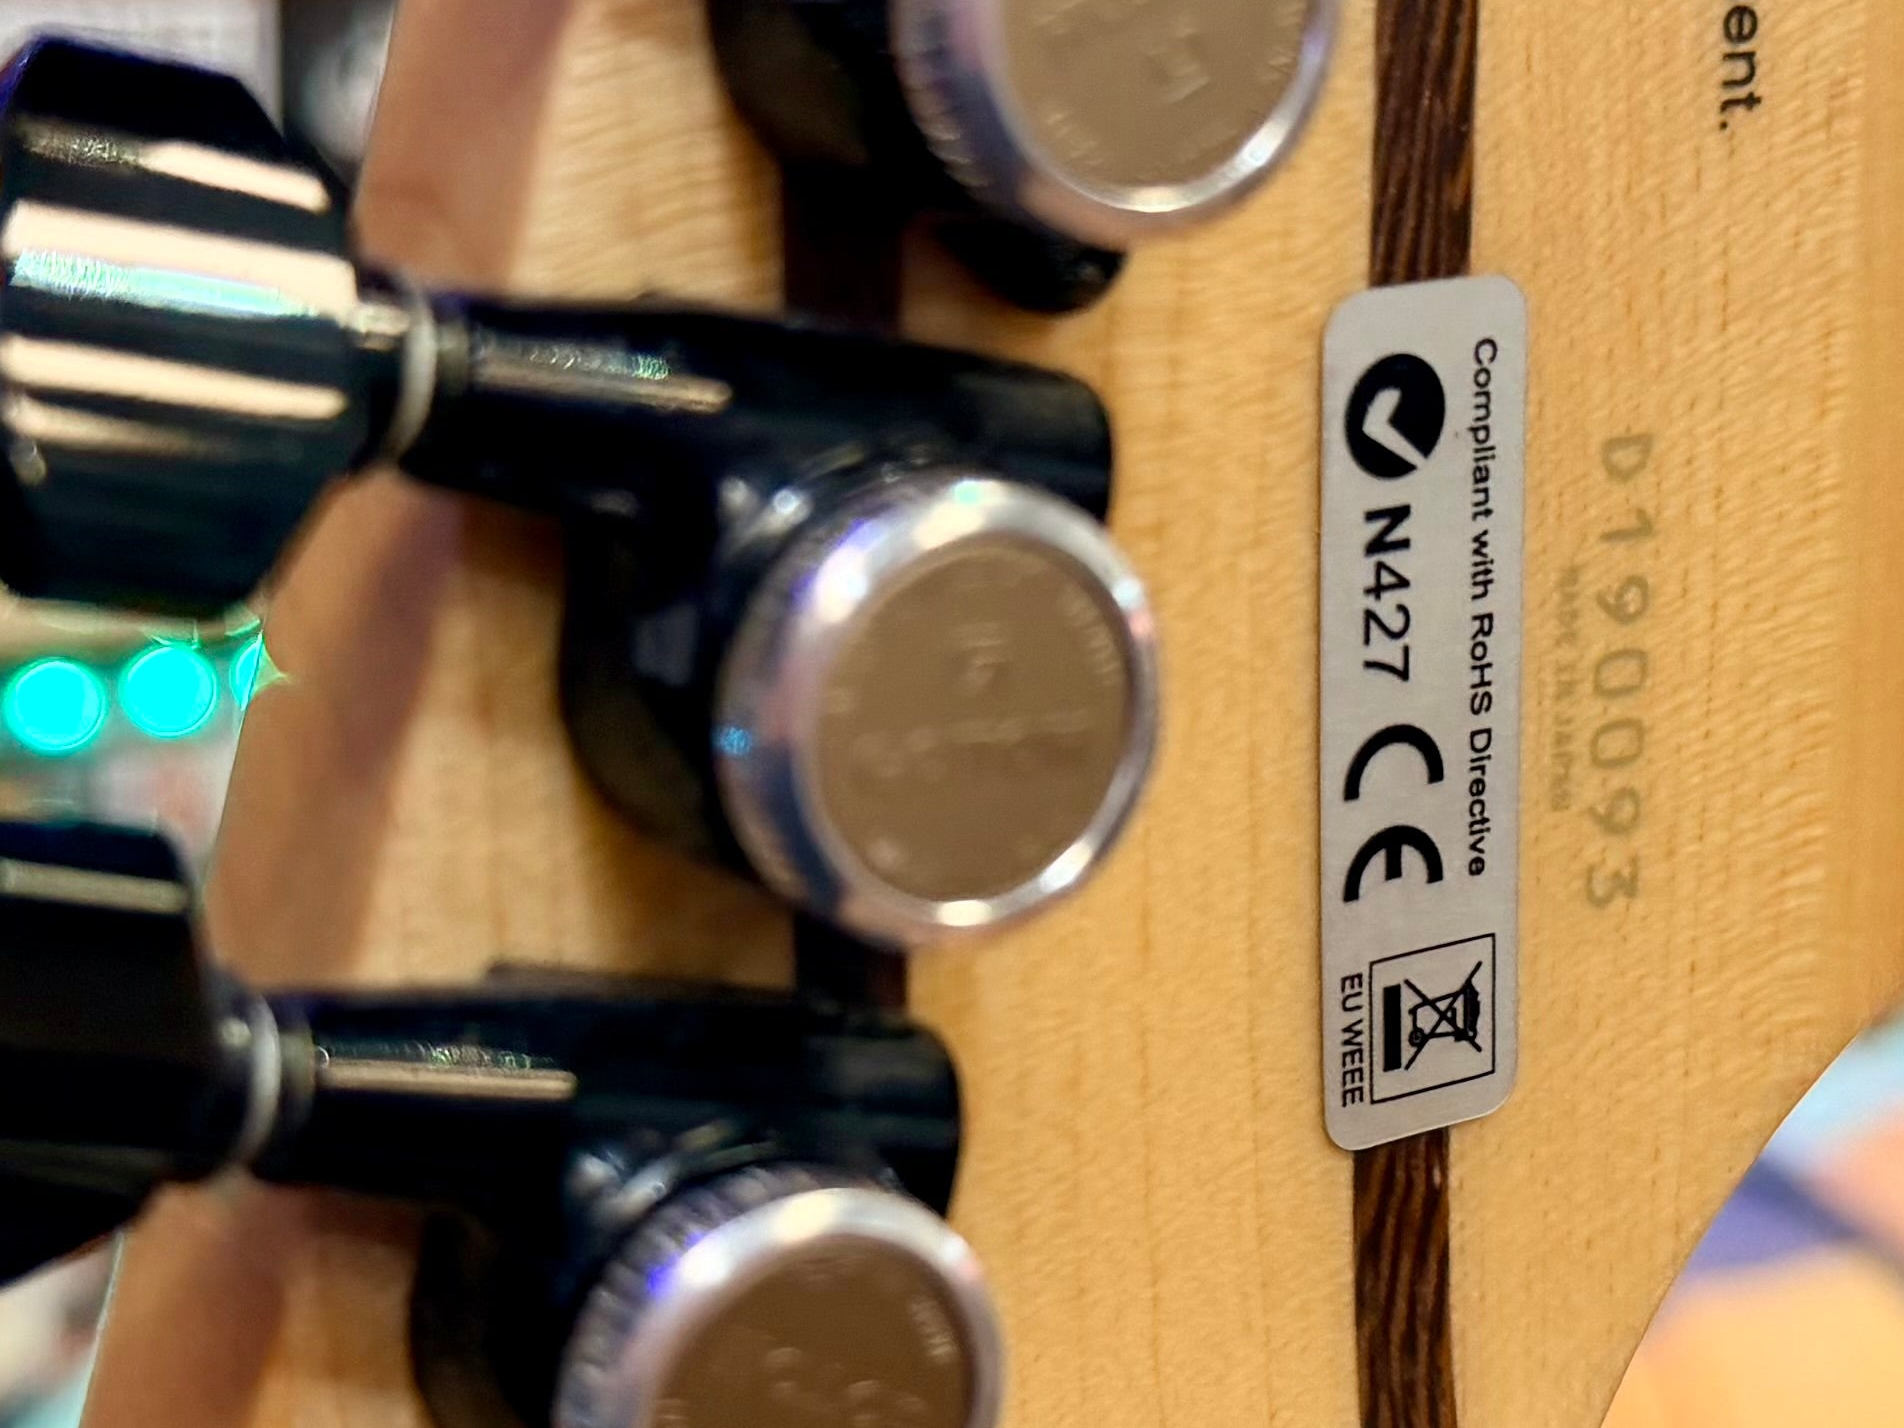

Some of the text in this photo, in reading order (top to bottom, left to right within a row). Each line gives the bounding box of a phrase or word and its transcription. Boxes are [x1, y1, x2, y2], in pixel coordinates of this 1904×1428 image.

[1362, 503, 1412, 684] N427
[1468, 336, 1499, 878] Compliant with RoHS Directive
[1584, 432, 1656, 910] D190093
[1340, 972, 1365, 1109] EU WEEE
